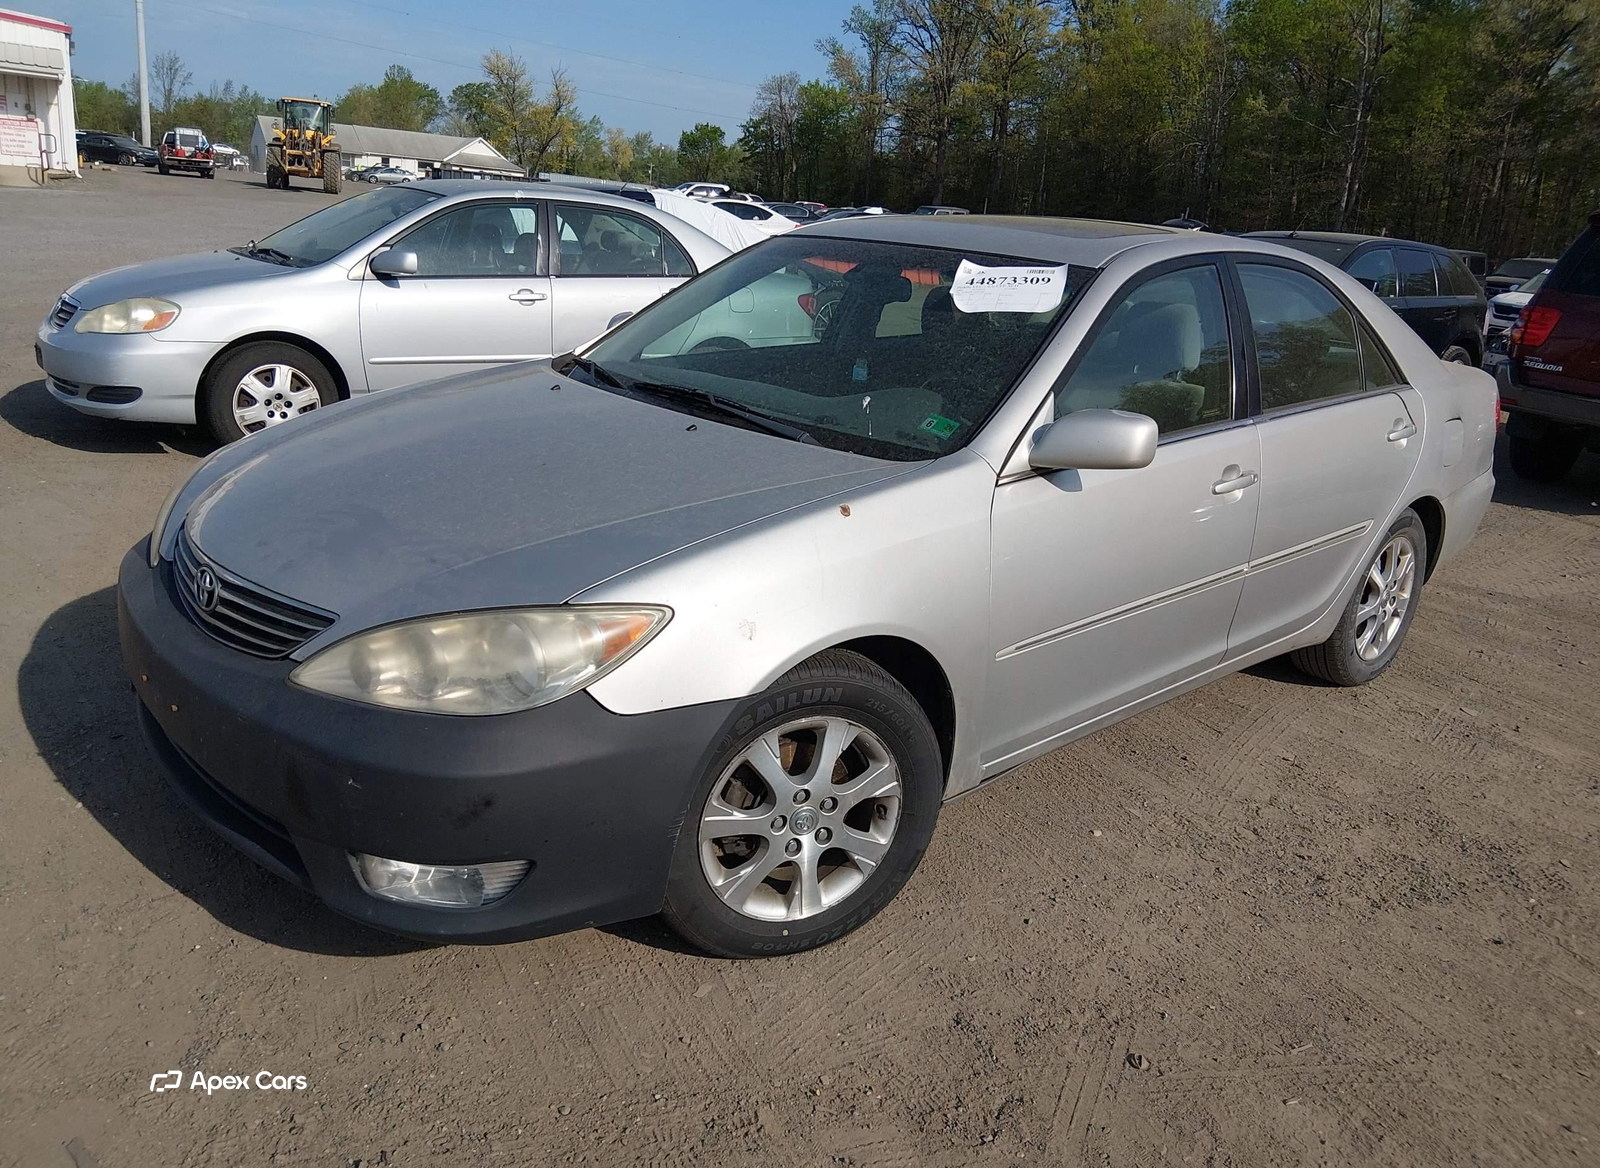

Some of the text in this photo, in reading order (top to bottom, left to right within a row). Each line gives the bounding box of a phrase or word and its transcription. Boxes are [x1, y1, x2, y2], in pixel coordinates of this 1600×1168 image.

[965, 276, 1051, 286] 44873309
[1523, 360, 1563, 371] SEQUOIA
[925, 420, 935, 428] 6
[735, 688, 843, 735] SAILUN
